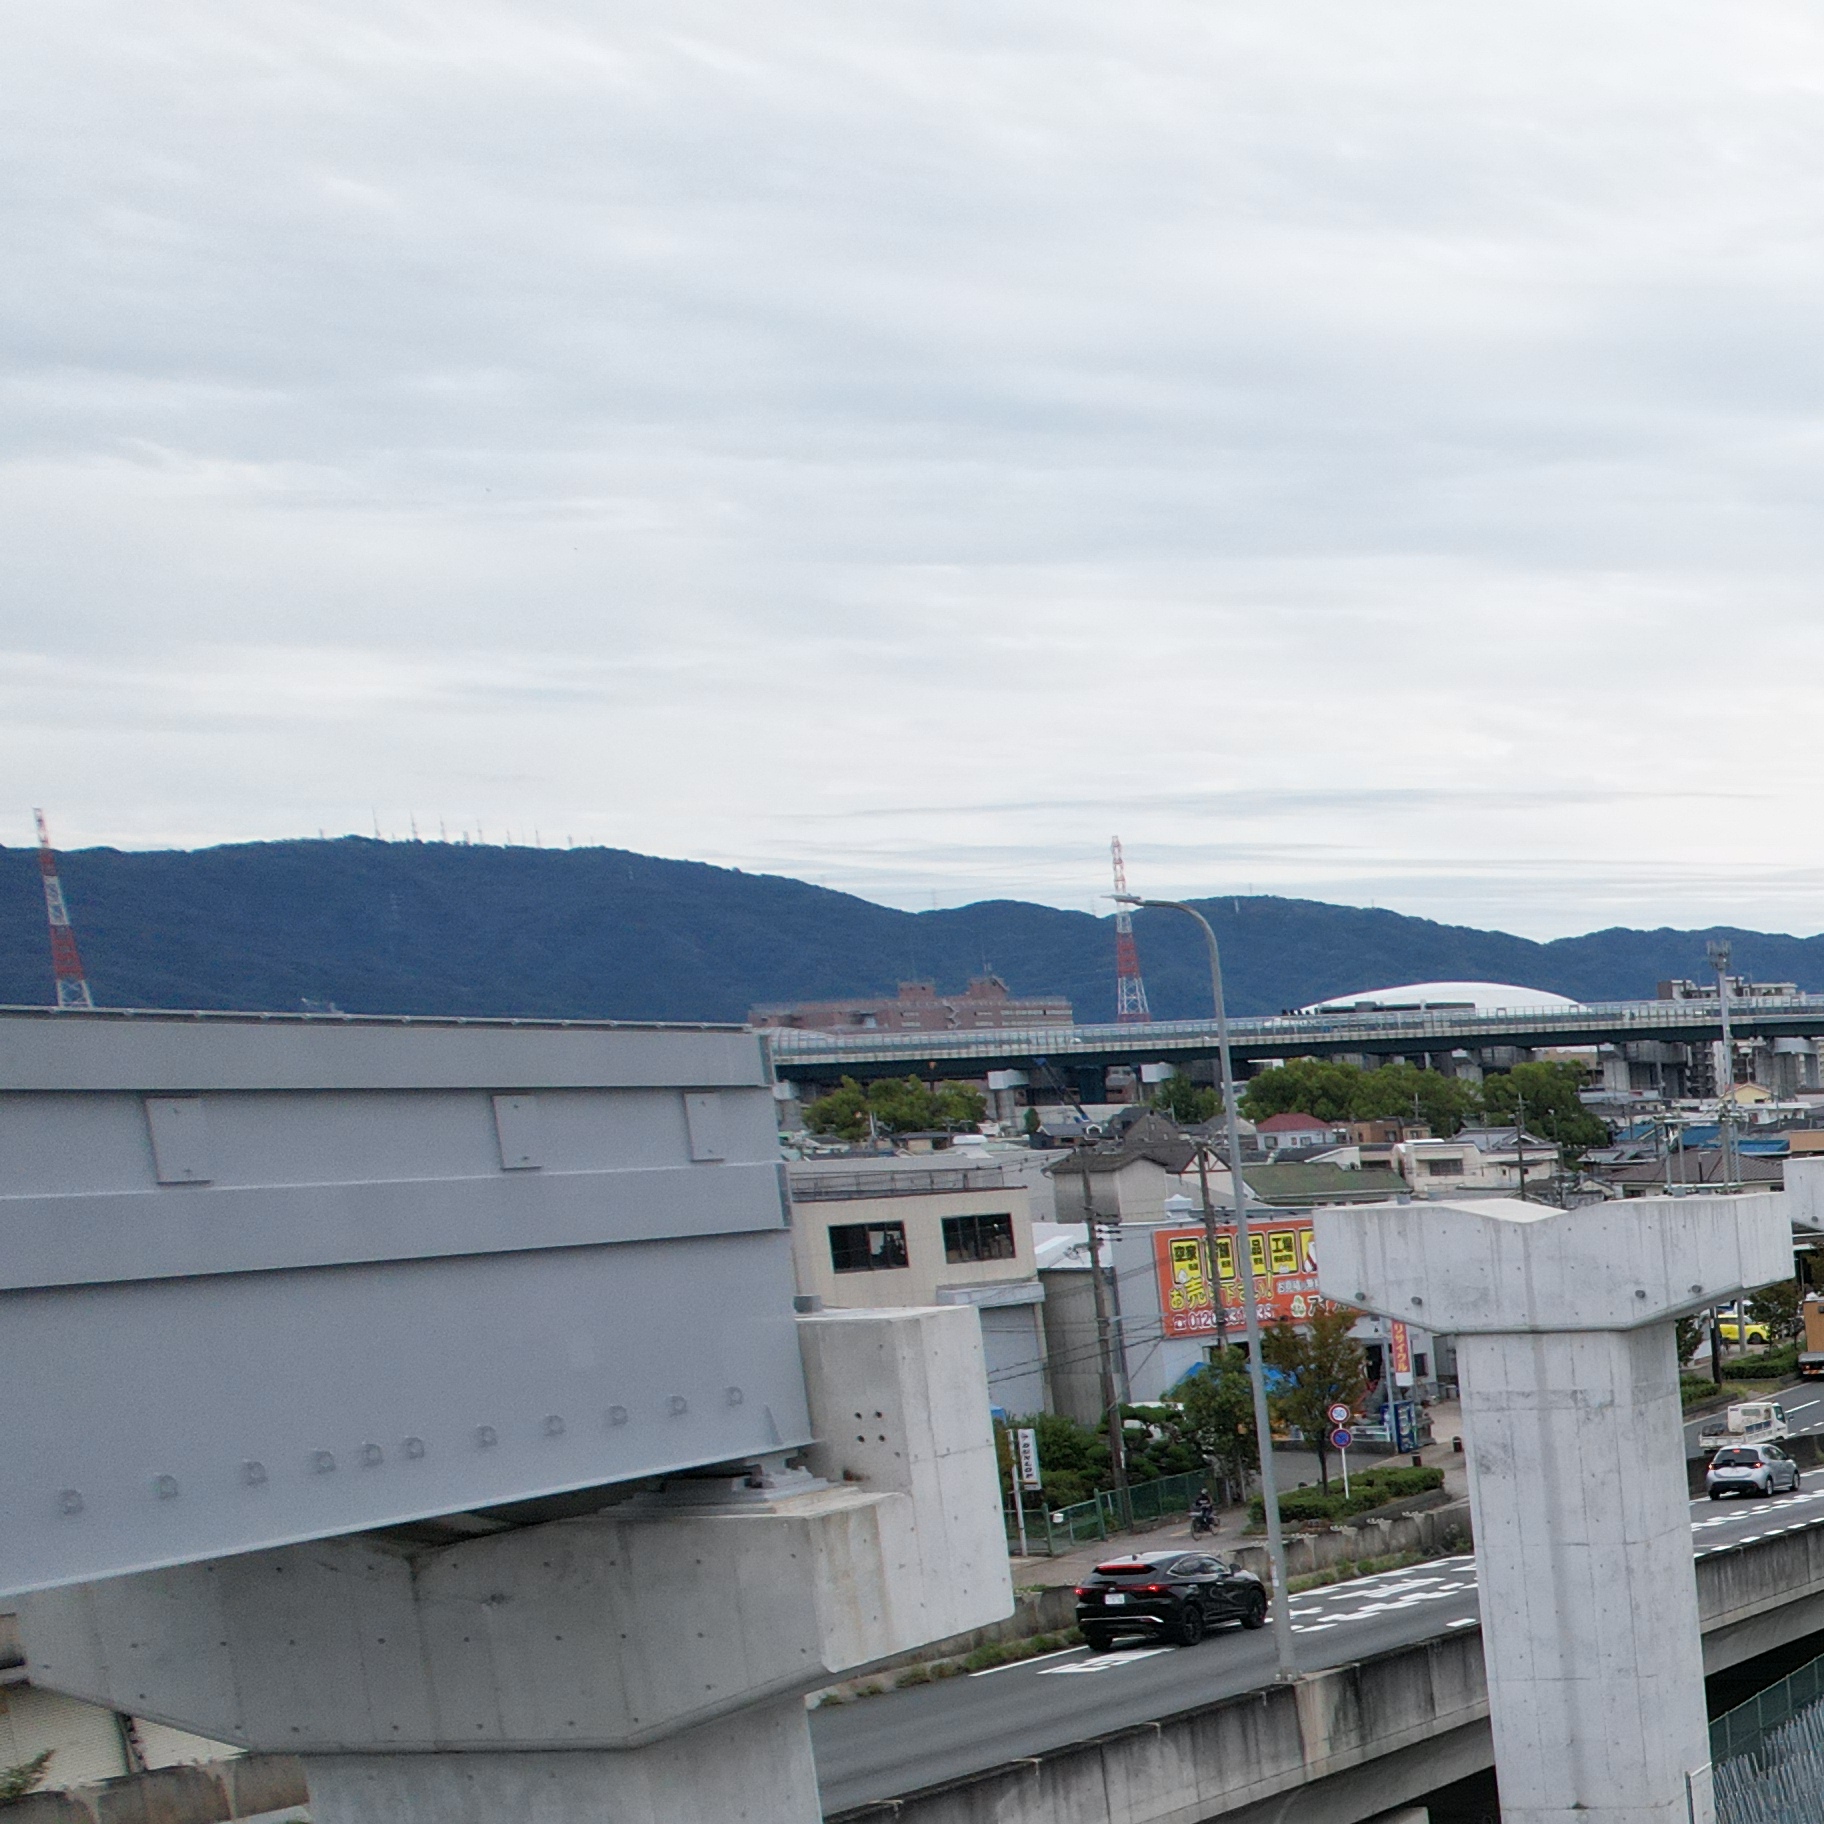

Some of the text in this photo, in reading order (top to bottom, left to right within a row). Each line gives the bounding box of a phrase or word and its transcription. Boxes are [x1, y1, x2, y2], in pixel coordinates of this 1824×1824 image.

[1393, 1321, 1409, 1372] リサイクル
